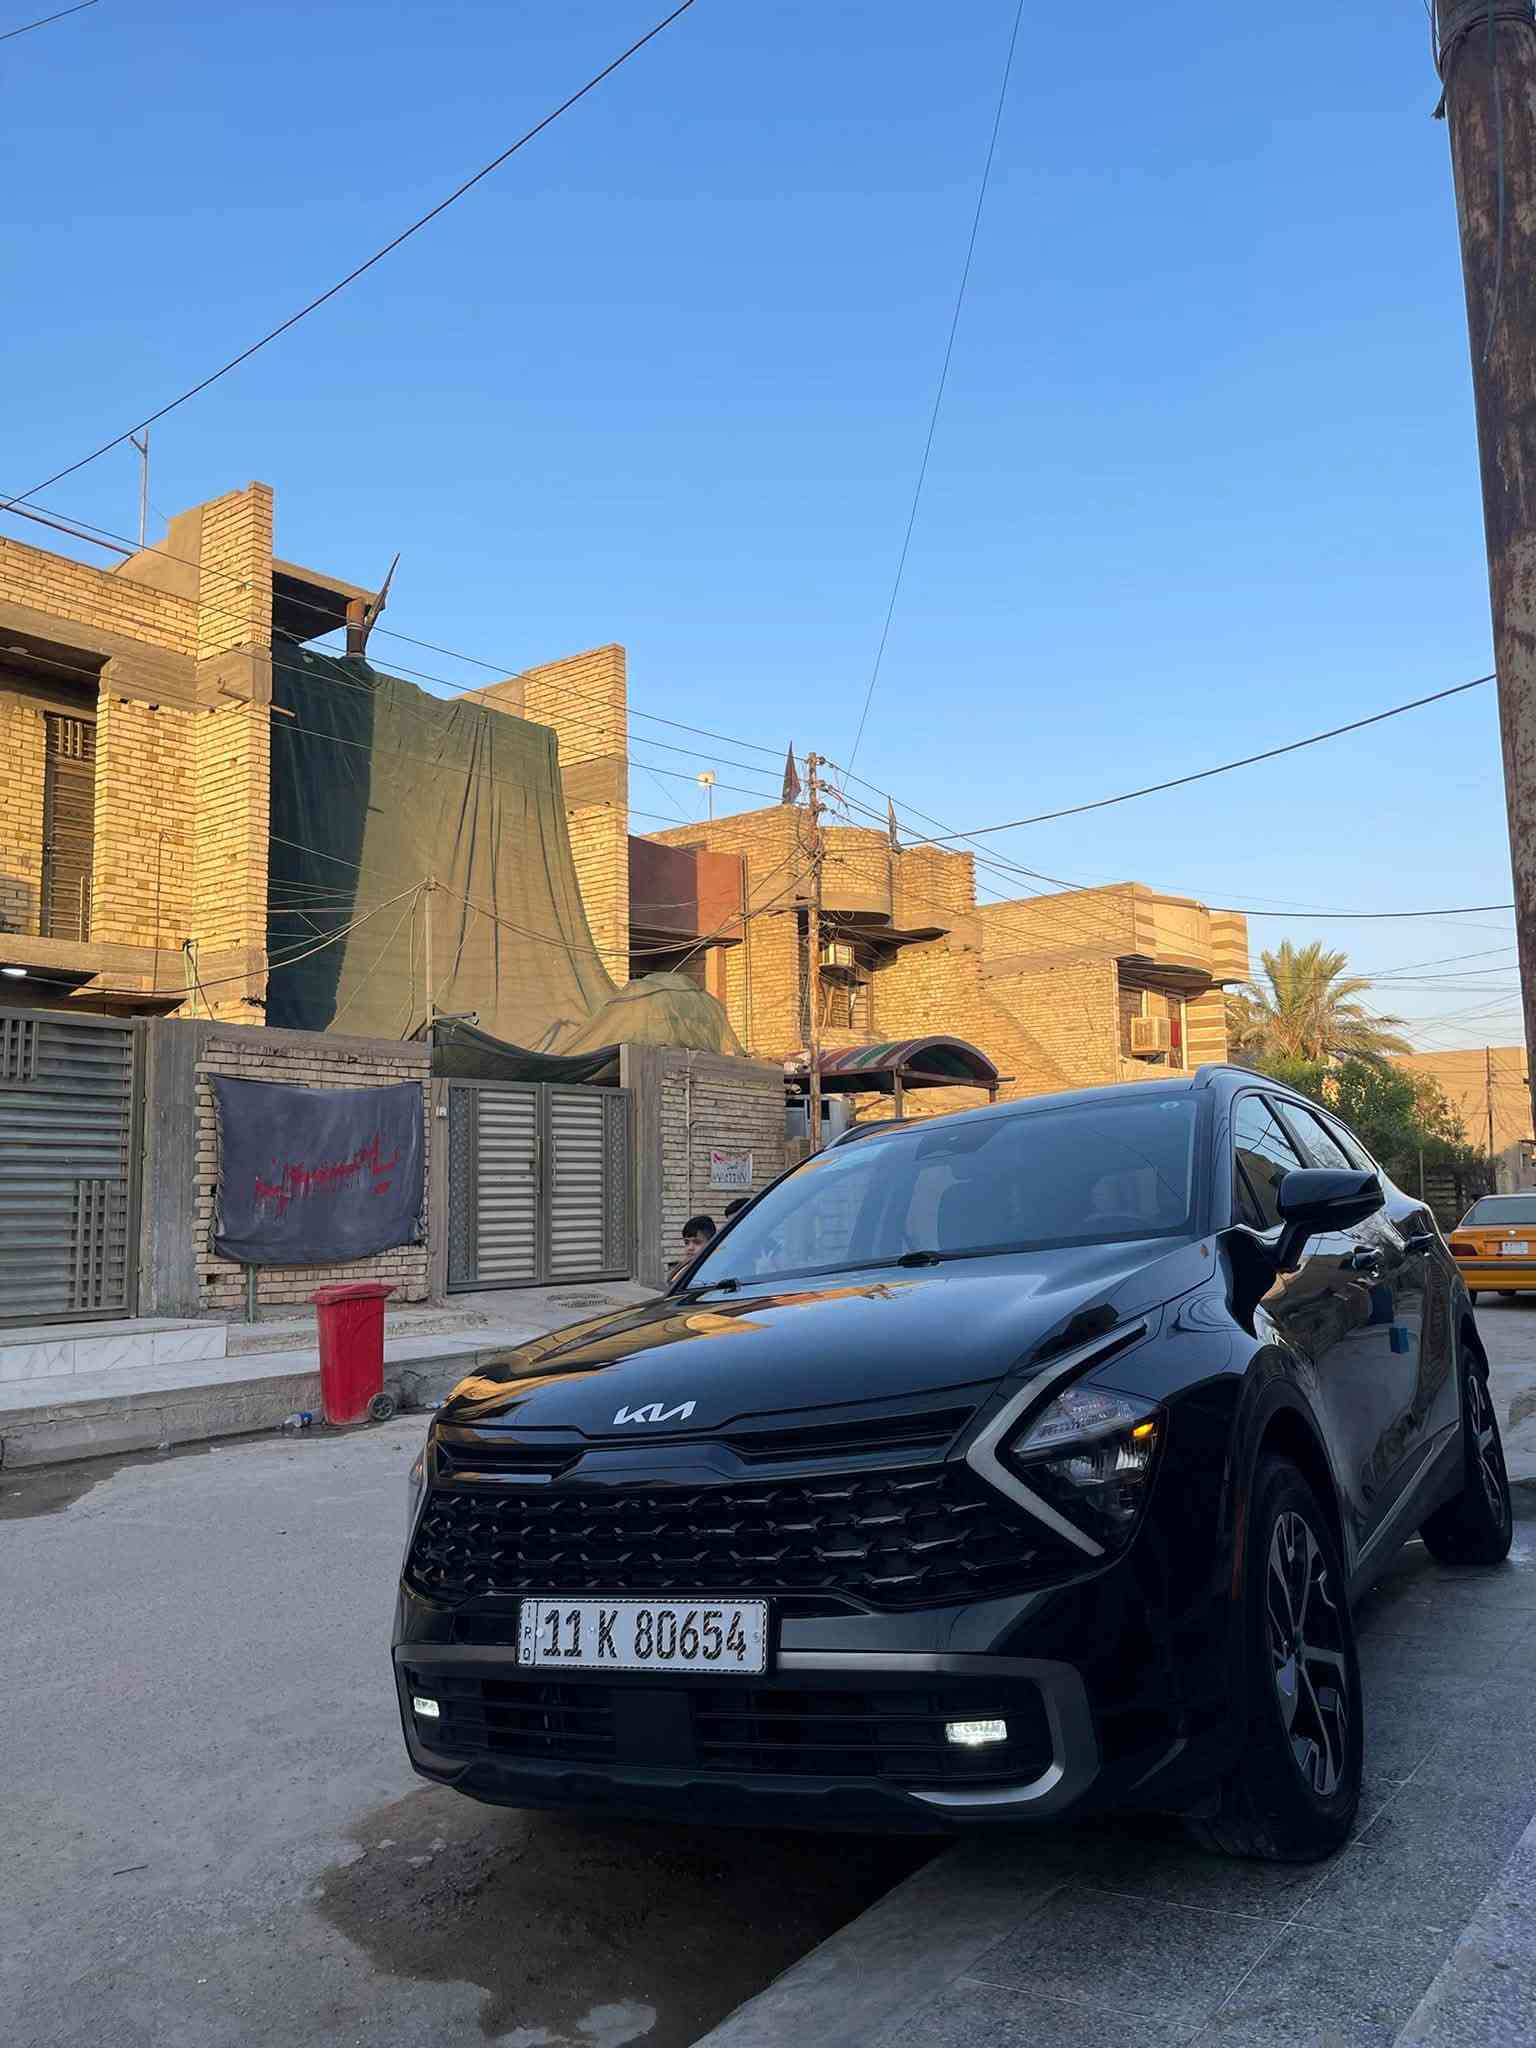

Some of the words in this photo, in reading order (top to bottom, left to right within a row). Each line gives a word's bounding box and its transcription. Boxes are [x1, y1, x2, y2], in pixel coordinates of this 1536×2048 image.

[613, 1400, 697, 1425] KIA
[543, 1609, 582, 1657] 11
[598, 1610, 618, 1658] K
[635, 1609, 746, 1661] 80654
